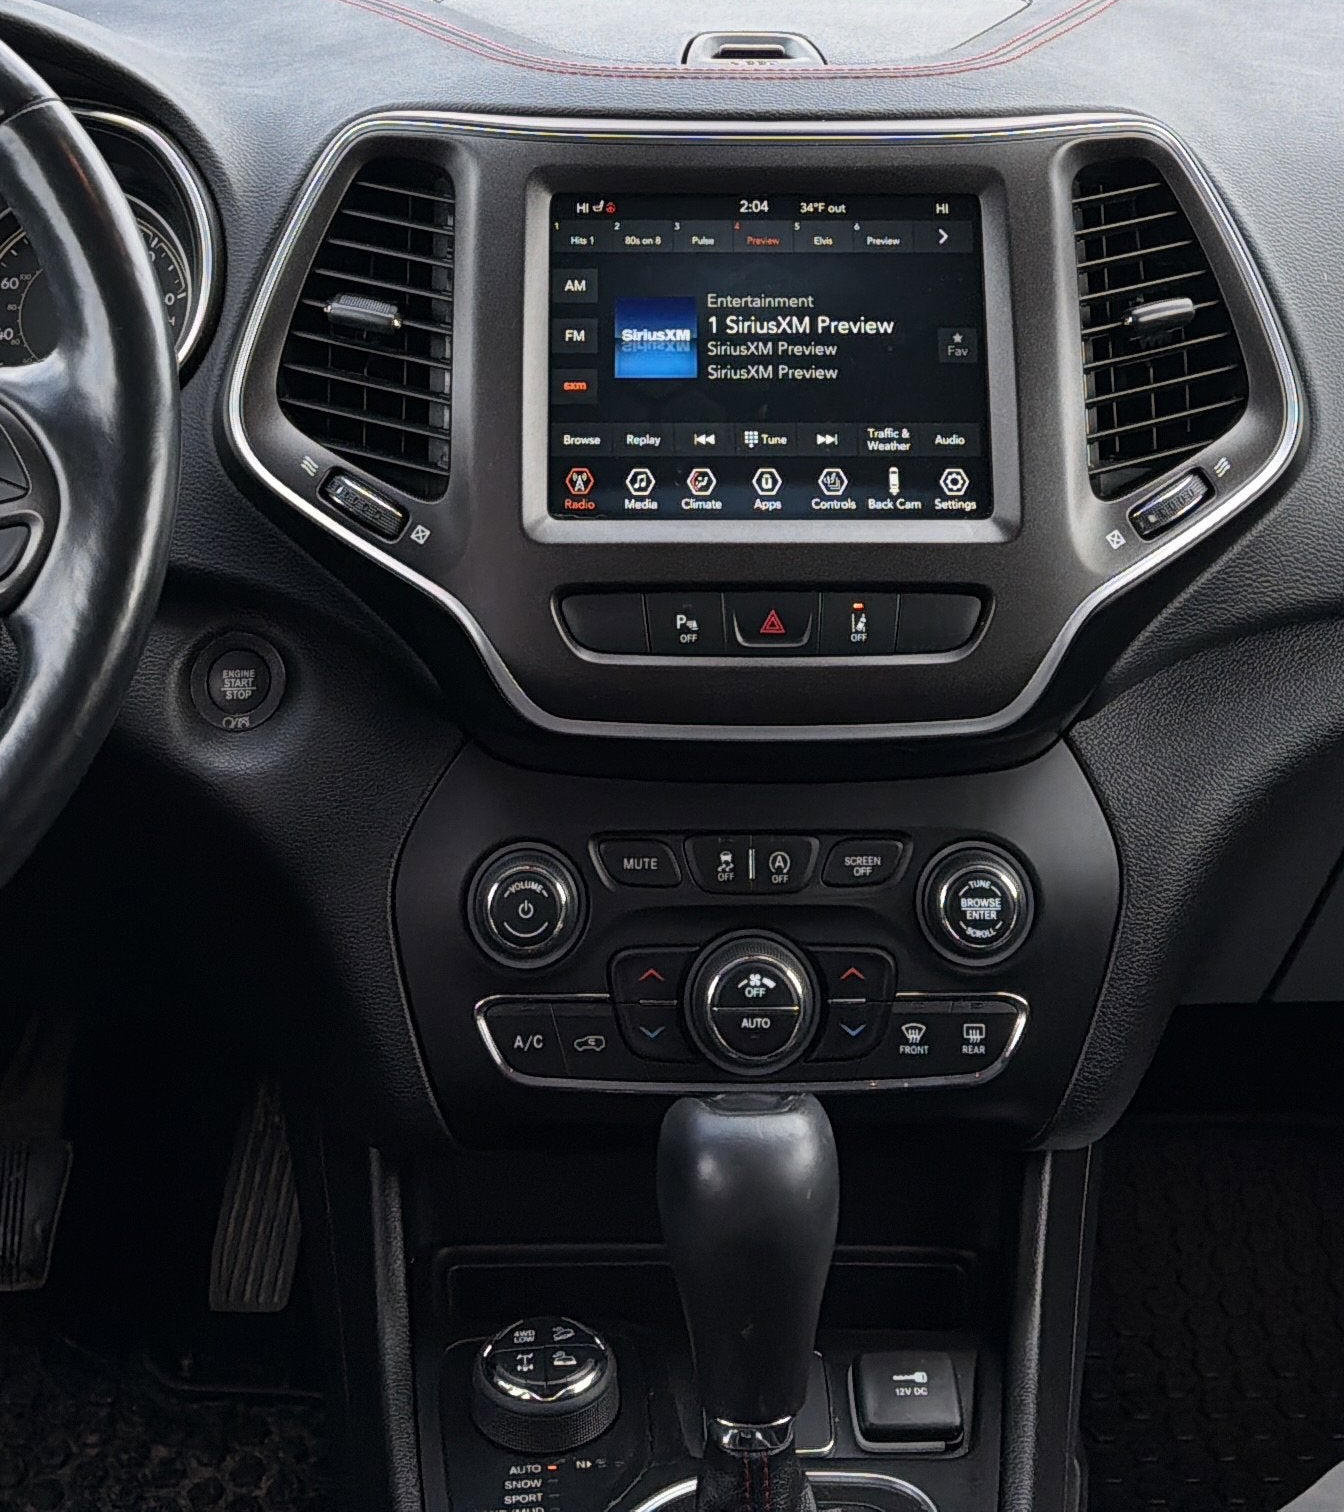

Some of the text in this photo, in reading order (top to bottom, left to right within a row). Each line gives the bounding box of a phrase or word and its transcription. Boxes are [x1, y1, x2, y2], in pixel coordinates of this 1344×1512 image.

[576, 202, 590, 215] HI
[739, 199, 769, 214] 2:04
[799, 202, 847, 215] 34°F out
[935, 203, 950, 216] HI
[570, 235, 588, 247] Hits
[624, 235, 640, 247] 80s
[642, 237, 653, 247] on
[691, 235, 715, 247] Pulse
[746, 235, 781, 247] Preview
[813, 235, 834, 247] Elvis
[866, 235, 901, 247] Preview
[0, 277, 20, 290] 60
[564, 280, 587, 292] AM
[707, 293, 814, 309] Entertainment
[708, 316, 895, 335] 1 SiriusXM Preview
[565, 329, 586, 342] FM
[621, 328, 691, 343] SiriusXM
[707, 341, 838, 356] SiriusXM Preview
[947, 346, 969, 358] Fav
[707, 365, 838, 380] SiriusXM Preview
[563, 434, 601, 446] Browse
[760, 434, 788, 446] Tune
[867, 428, 910, 440] Traffic &
[934, 434, 966, 446] Audio
[626, 434, 661, 448] Replay
[867, 440, 911, 451] Weather
[564, 498, 596, 511] Radio
[624, 498, 658, 511] Media
[681, 498, 723, 511] Climate
[753, 498, 782, 513] Apps
[811, 498, 857, 511] Controls
[867, 498, 922, 511] Back Cam
[934, 498, 977, 513] Settings
[676, 614, 687, 630] P
[680, 633, 698, 643] OFF
[850, 632, 868, 643] OFF
[222, 669, 256, 679] ENGINE
[223, 678, 254, 688] START
[225, 690, 252, 700] STOP
[623, 857, 658, 870] MUTE
[844, 856, 881, 867] SCREEN
[717, 872, 735, 882] OFF
[853, 867, 872, 877] OFF
[771, 874, 789, 884] OFF
[968, 879, 991, 889] TUNE
[507, 880, 544, 893] VOLUME
[960, 897, 1002, 908] BROWSE
[966, 910, 997, 921] ENTER
[965, 927, 996, 938] SCROLL
[744, 987, 766, 999] OFF
[740, 1018, 771, 1029] AUTO
[513, 1034, 544, 1050] A/C
[899, 1045, 929, 1055] FRONT
[961, 1044, 986, 1055] REAR
[513, 1329, 536, 1338] 4WD
[513, 1336, 535, 1344] LOW
[894, 1386, 912, 1397] 12V
[509, 1464, 542, 1475] AUTO
[504, 1479, 543, 1490] SNOW
[503, 1493, 544, 1505] SPORT
